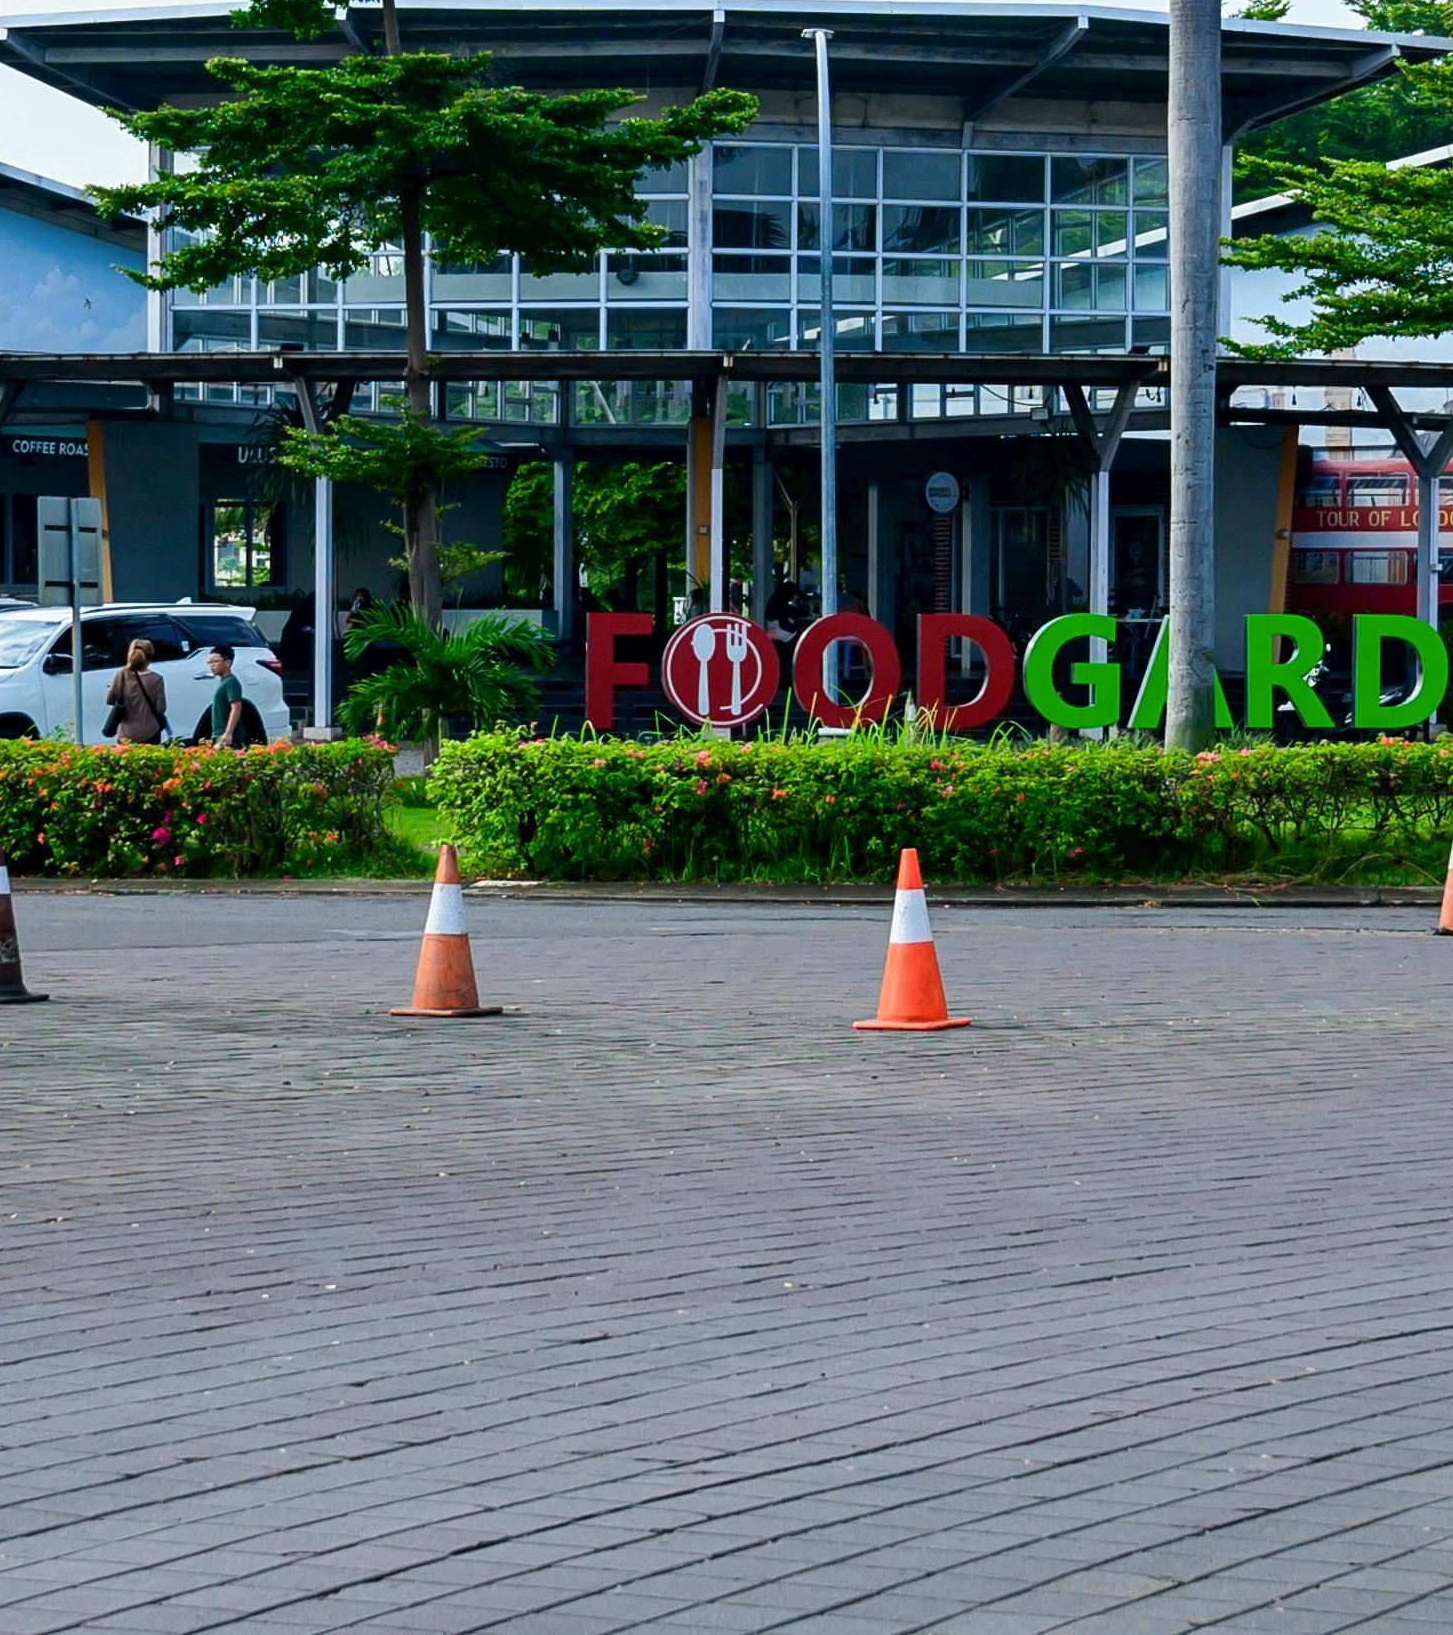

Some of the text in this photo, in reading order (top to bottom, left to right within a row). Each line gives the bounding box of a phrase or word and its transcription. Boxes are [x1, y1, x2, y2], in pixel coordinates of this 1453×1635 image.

[12, 439, 56, 455] COFFEE
[1316, 510, 1359, 527] TOUR
[1368, 510, 1392, 527] OF
